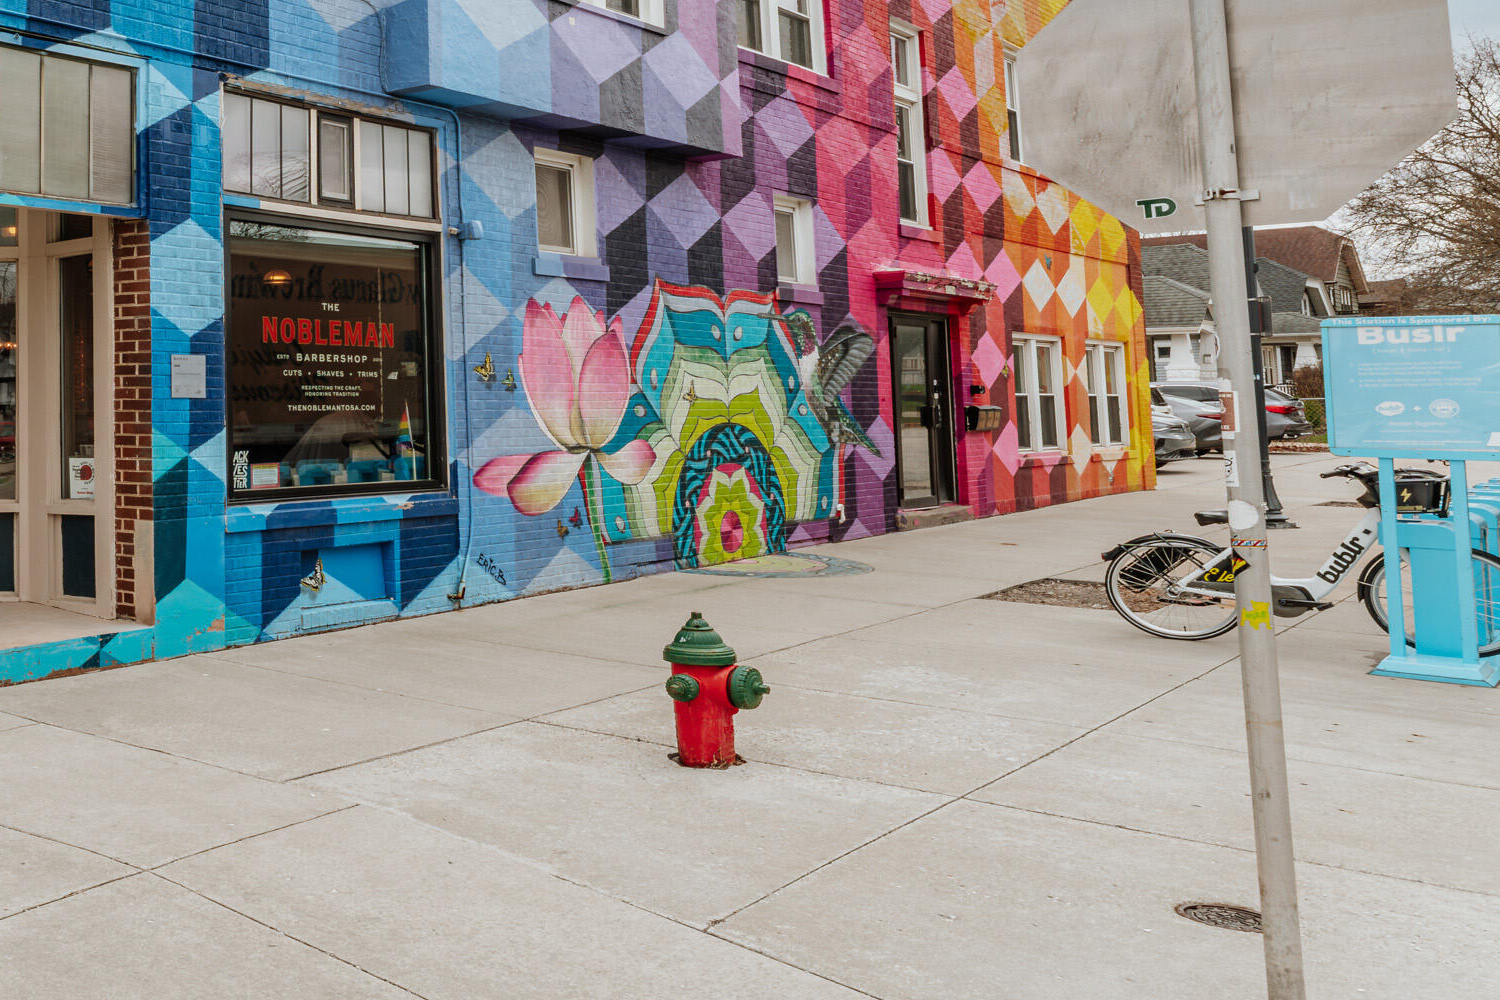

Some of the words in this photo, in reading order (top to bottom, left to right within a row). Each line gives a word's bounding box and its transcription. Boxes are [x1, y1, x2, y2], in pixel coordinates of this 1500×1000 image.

[1135, 197, 1178, 219] TD
[321, 302, 340, 312] THE
[1409, 316, 1470, 325] Sponsored
[261, 316, 395, 348] NOBLEMAN
[296, 353, 368, 364] BARBERSHOP
[283, 369, 303, 377] CUTS
[316, 369, 345, 378] SHAVES
[357, 370, 379, 379] TRIMS
[288, 404, 376, 412] THENOBLEMANTOSA.COM
[1315, 536, 1364, 586] bublr
